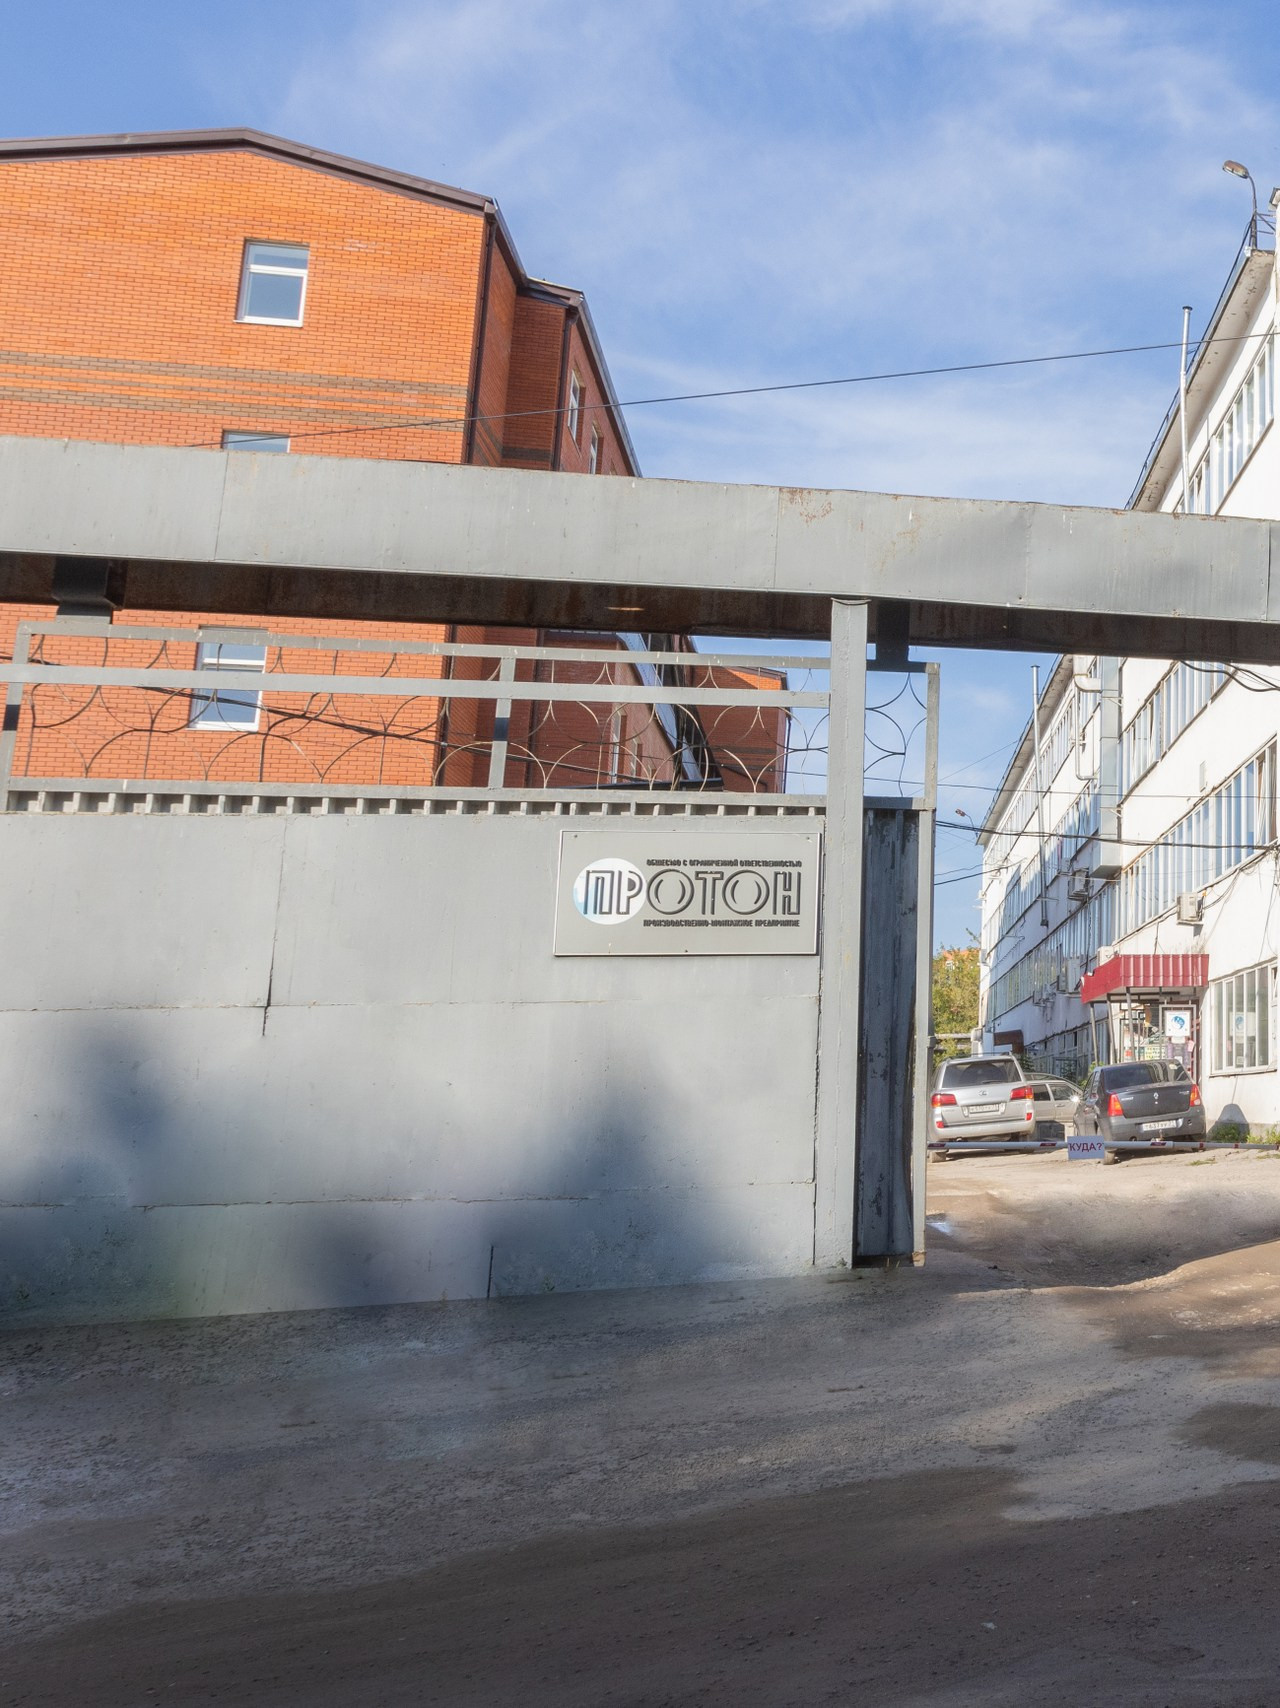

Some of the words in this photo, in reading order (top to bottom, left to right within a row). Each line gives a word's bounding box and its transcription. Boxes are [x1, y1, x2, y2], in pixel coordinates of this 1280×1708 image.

[688, 859, 739, 867] ОГРАНИЧЕННОЙ
[739, 859, 803, 868] ОТВЕТСТВЕННОСТЬЮ
[583, 868, 801, 915] ПРОТОН
[754, 920, 800, 928] ПРЕДПРИЯТИЕ
